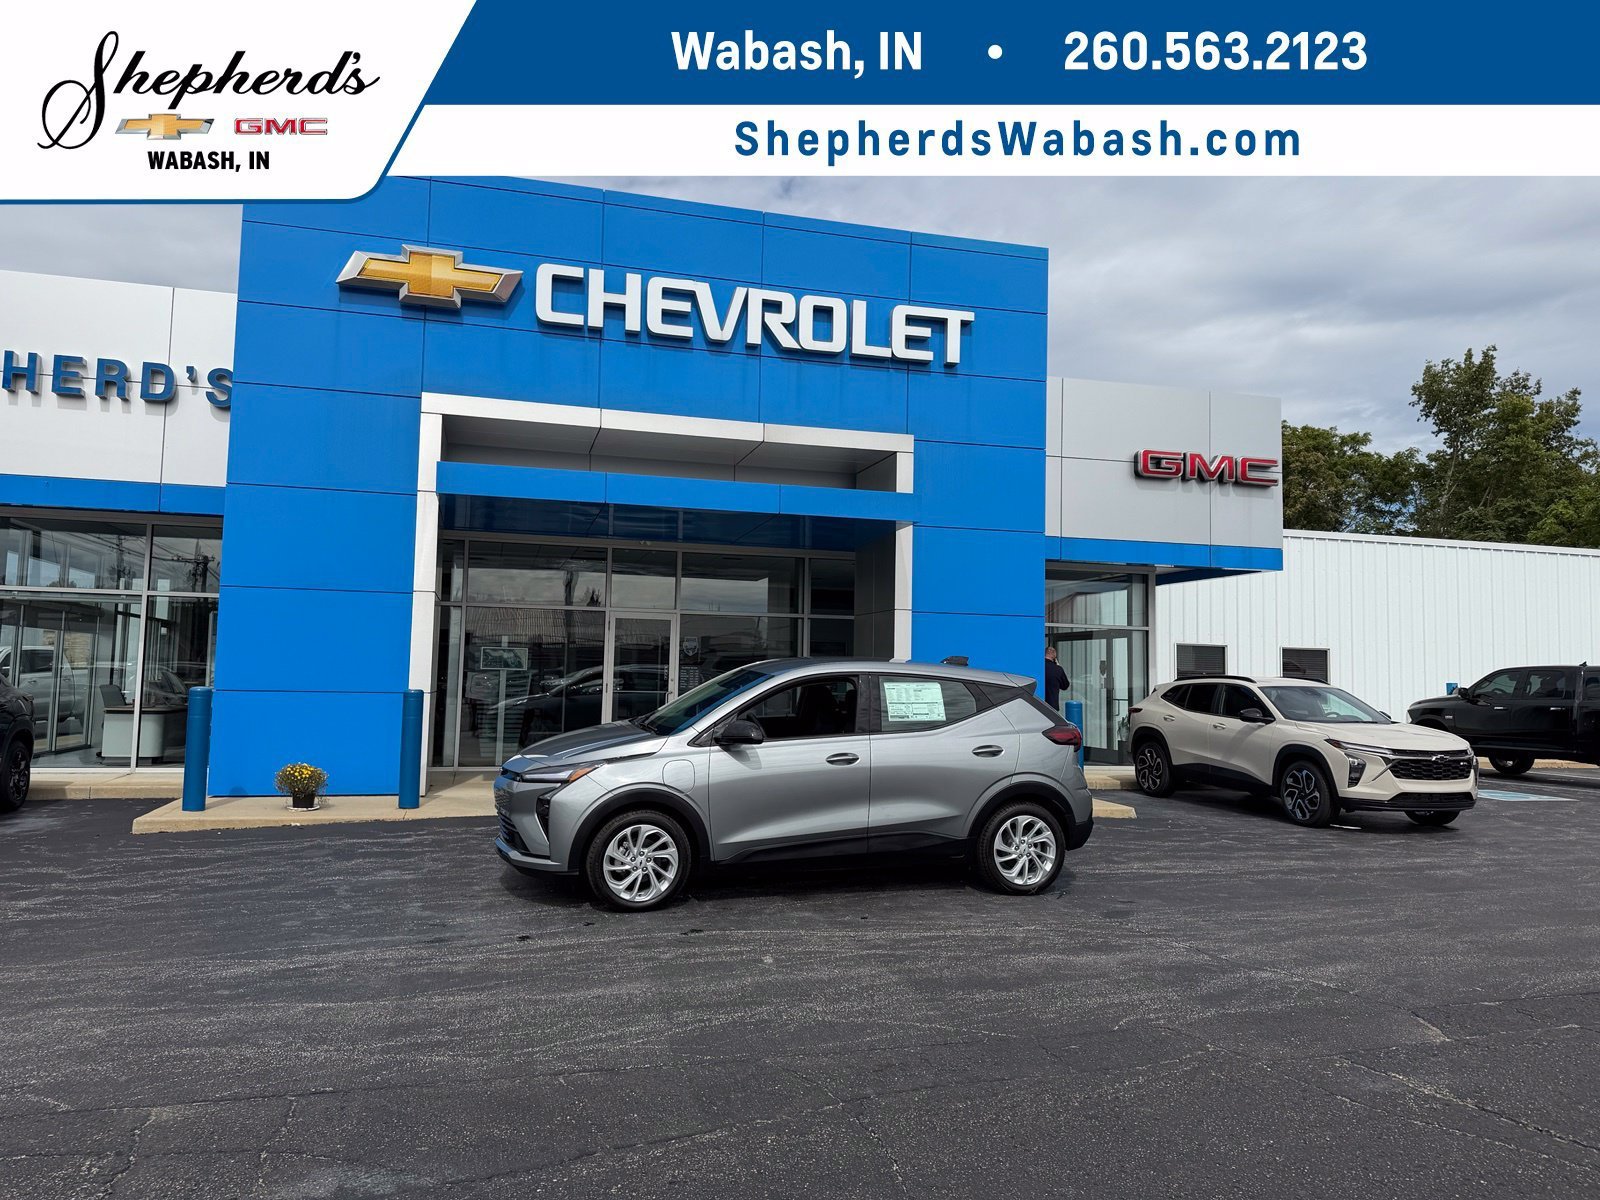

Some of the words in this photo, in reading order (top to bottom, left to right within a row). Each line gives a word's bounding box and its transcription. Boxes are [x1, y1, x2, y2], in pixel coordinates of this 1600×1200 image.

[535, 263, 975, 366] CHEVROLET
[1, 350, 234, 409] HERD'S
[1135, 449, 1279, 487] GMC
